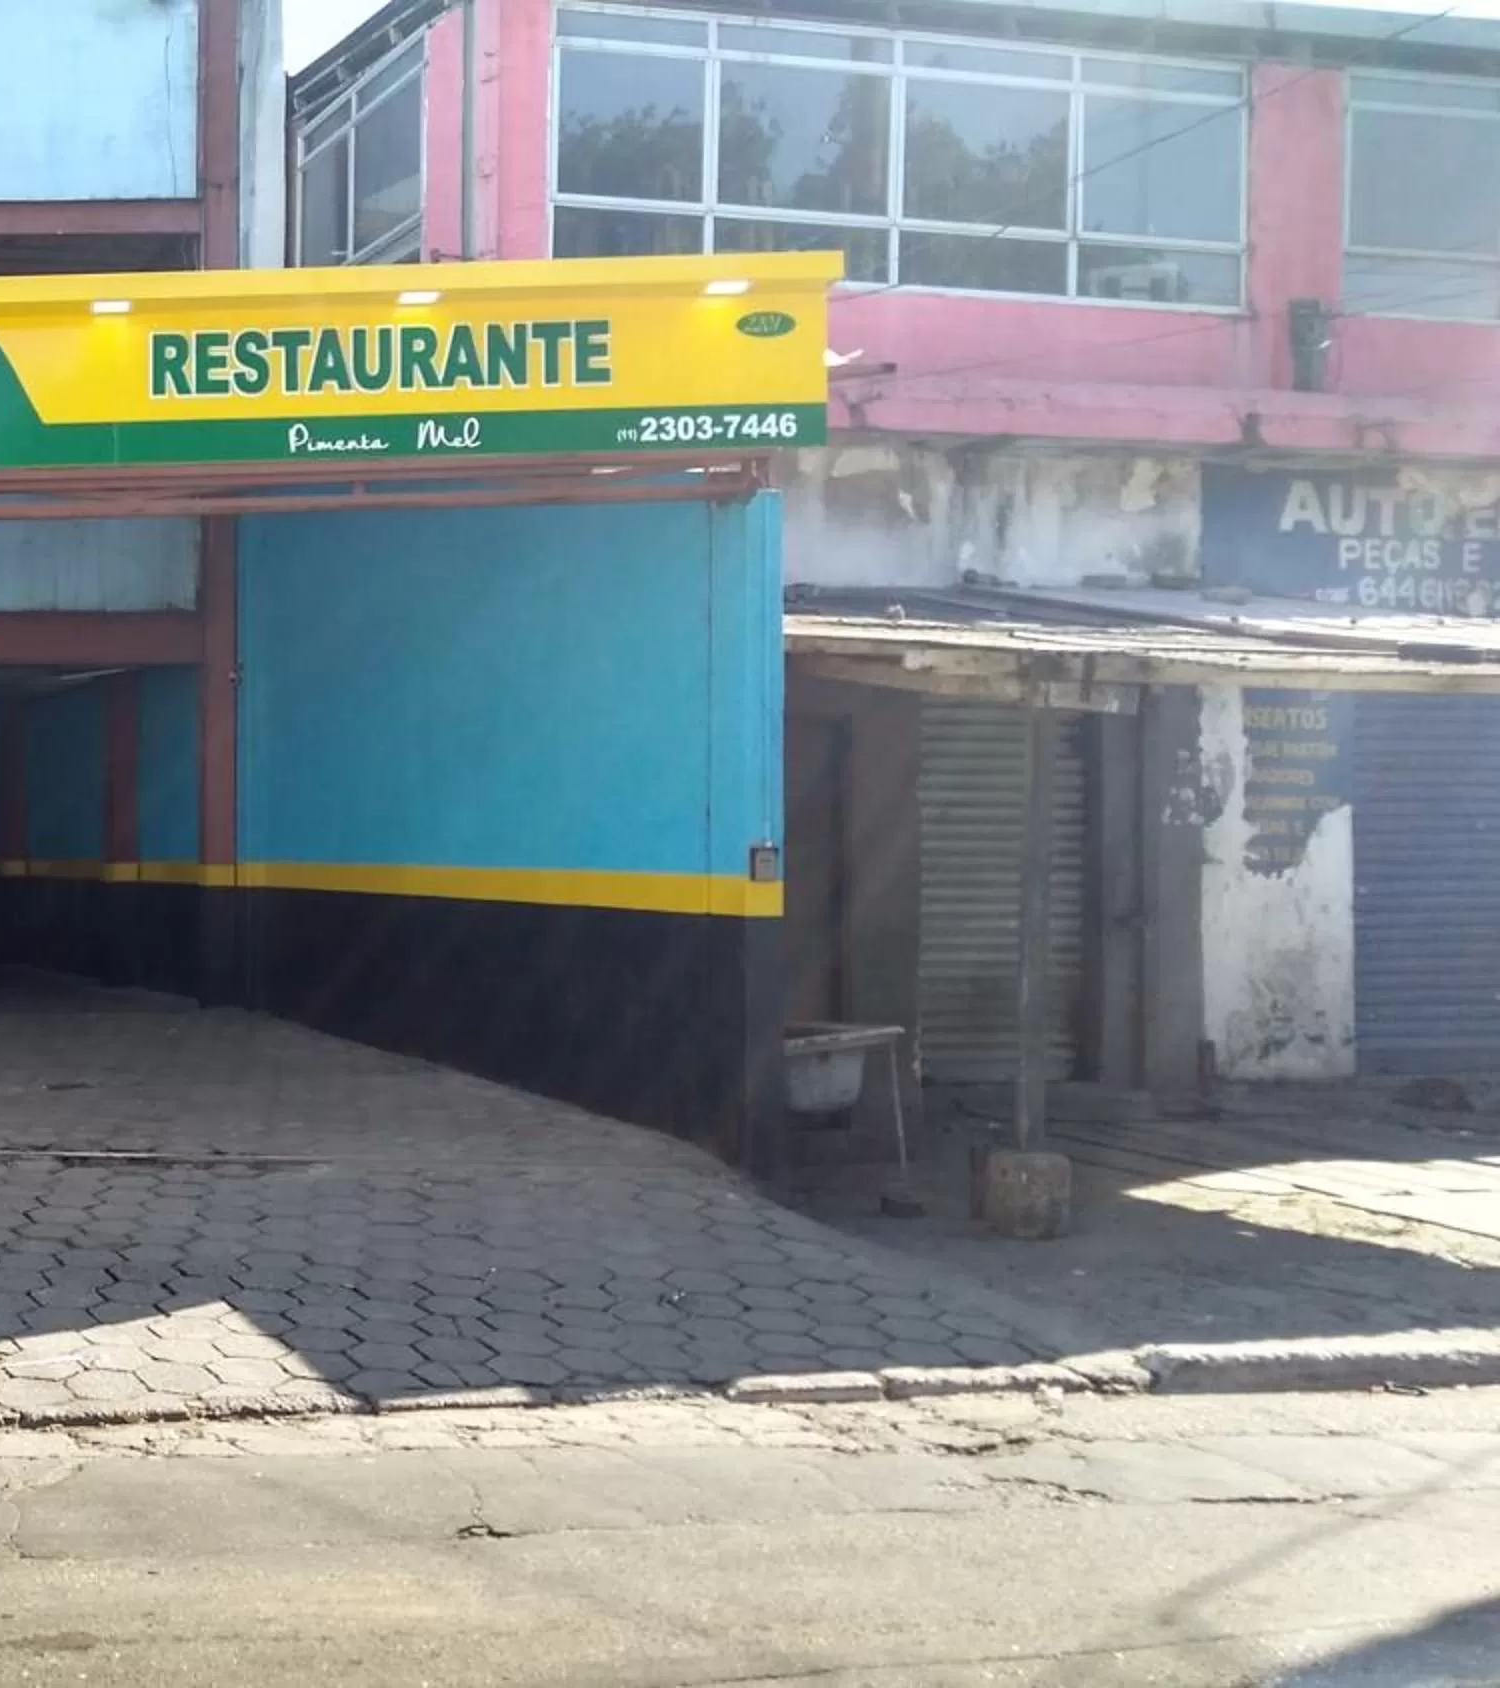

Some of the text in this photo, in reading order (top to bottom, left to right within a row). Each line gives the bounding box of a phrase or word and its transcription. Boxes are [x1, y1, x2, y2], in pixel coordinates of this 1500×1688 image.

[150, 320, 612, 398] RESTAURANTE
[288, 418, 481, 453] Pimenta Mel
[640, 413, 798, 441] 2303-7446
[1462, 541, 1483, 573] E
